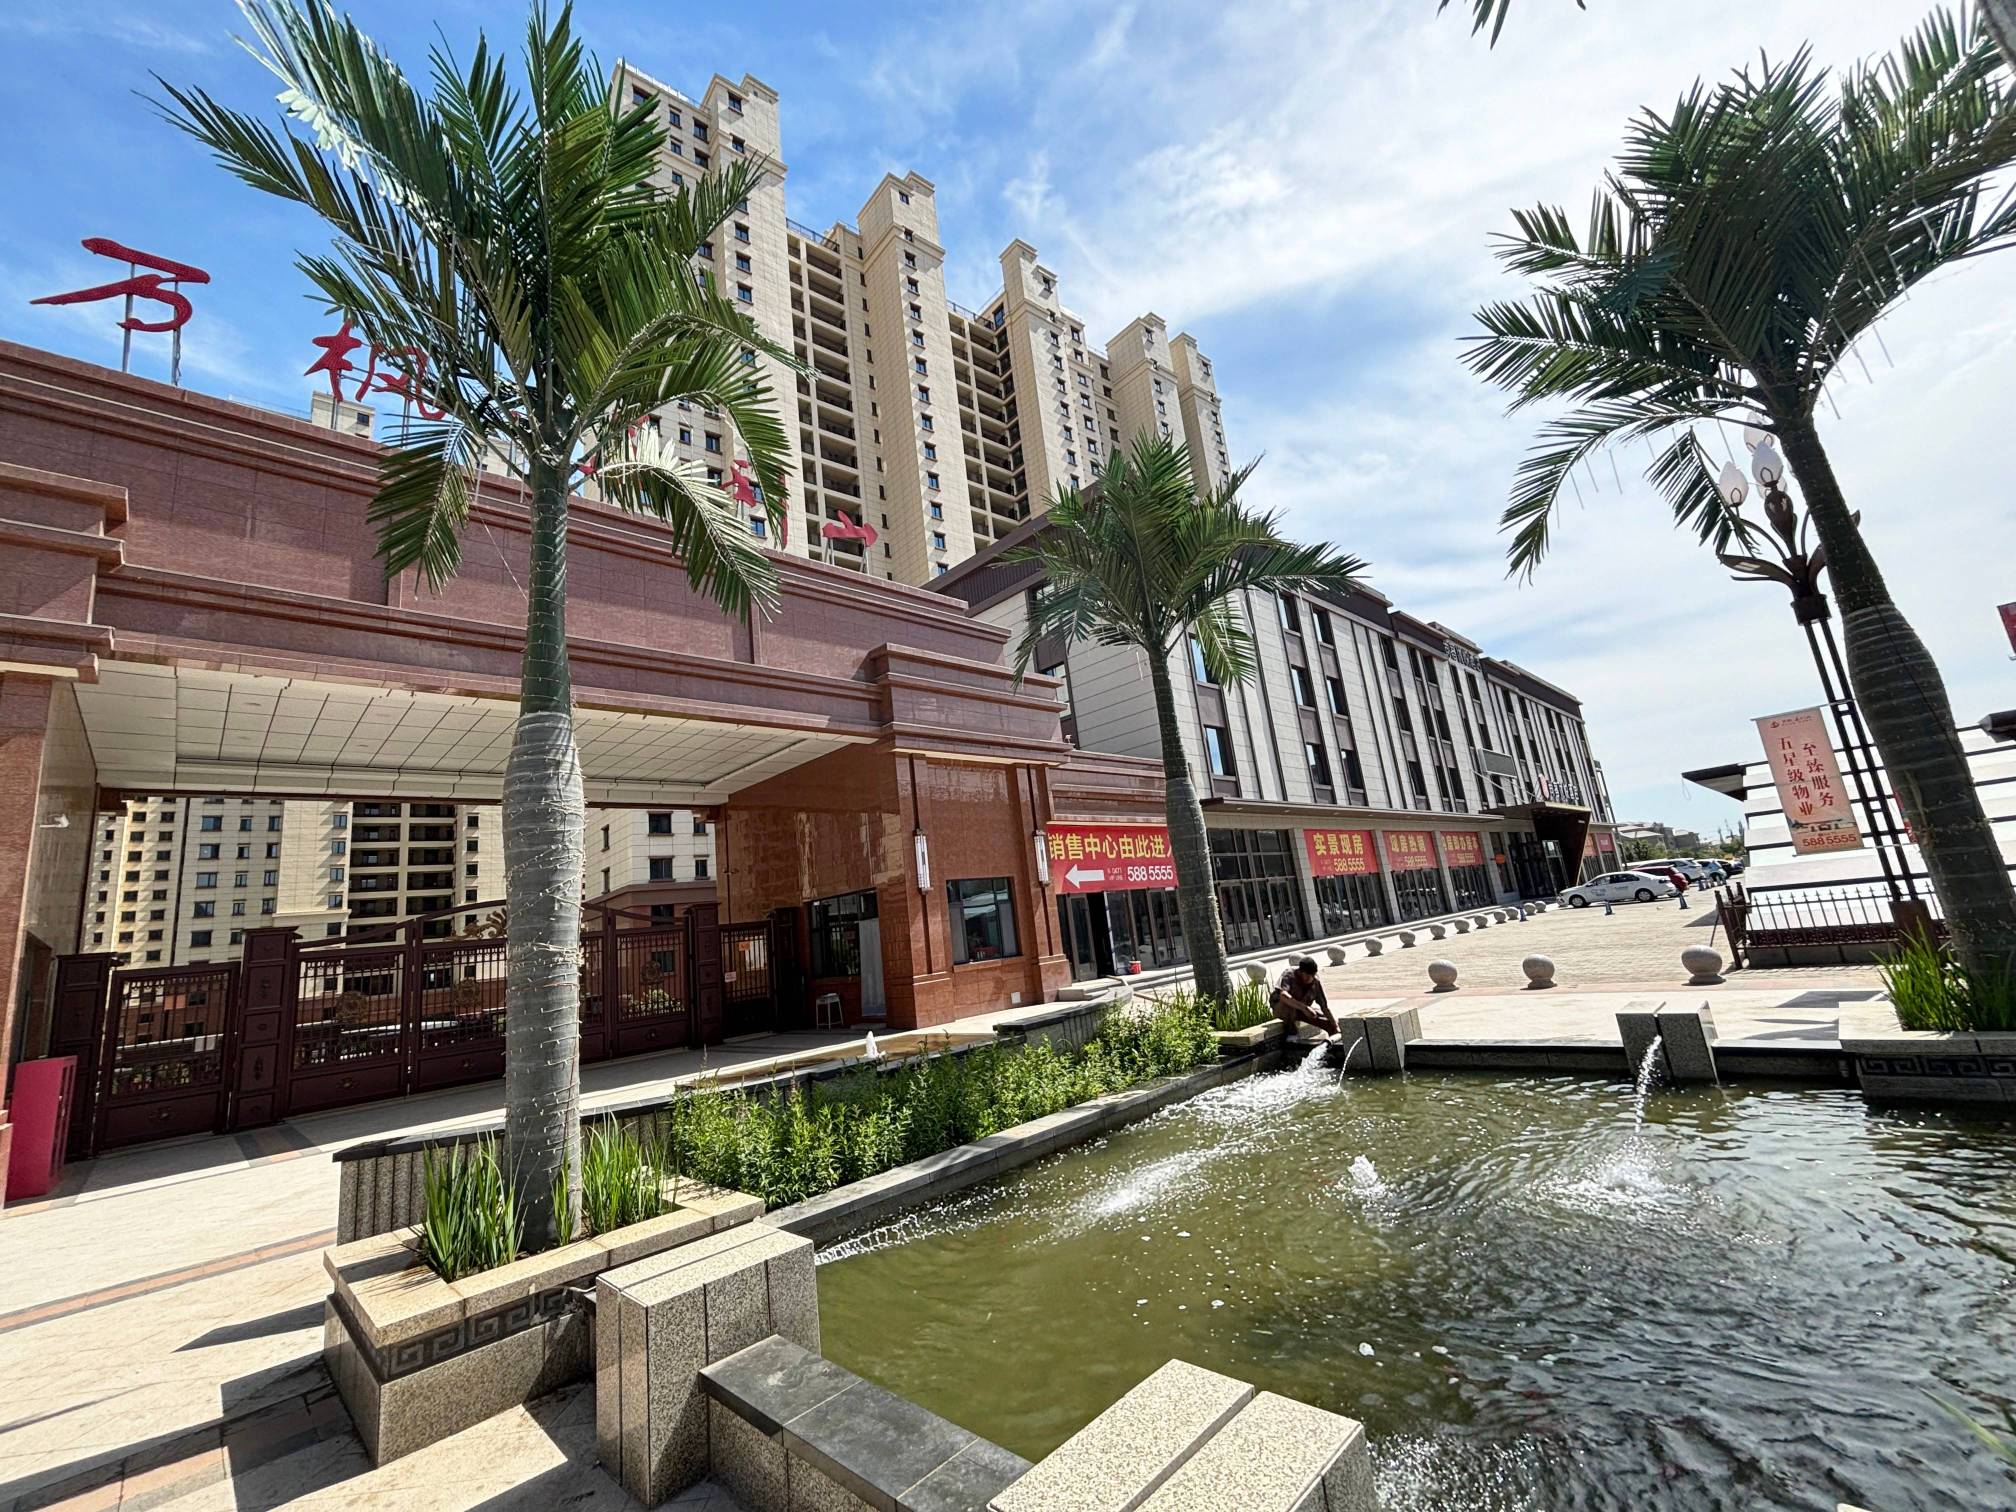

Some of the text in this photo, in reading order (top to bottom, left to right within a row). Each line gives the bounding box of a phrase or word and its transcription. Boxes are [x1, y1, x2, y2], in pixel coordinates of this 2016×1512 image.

[1779, 736, 1814, 816] 五星级物业
[1803, 742, 1834, 808] 至臻服务
[1312, 832, 1365, 856] 实景现房
[1803, 835, 1826, 847] 588
[1826, 833, 1857, 845] 5555
[1127, 866, 1148, 881] 588
[1148, 865, 1174, 880] 5555
[1333, 858, 1348, 872] 588
[1347, 858, 1366, 871] 5555
